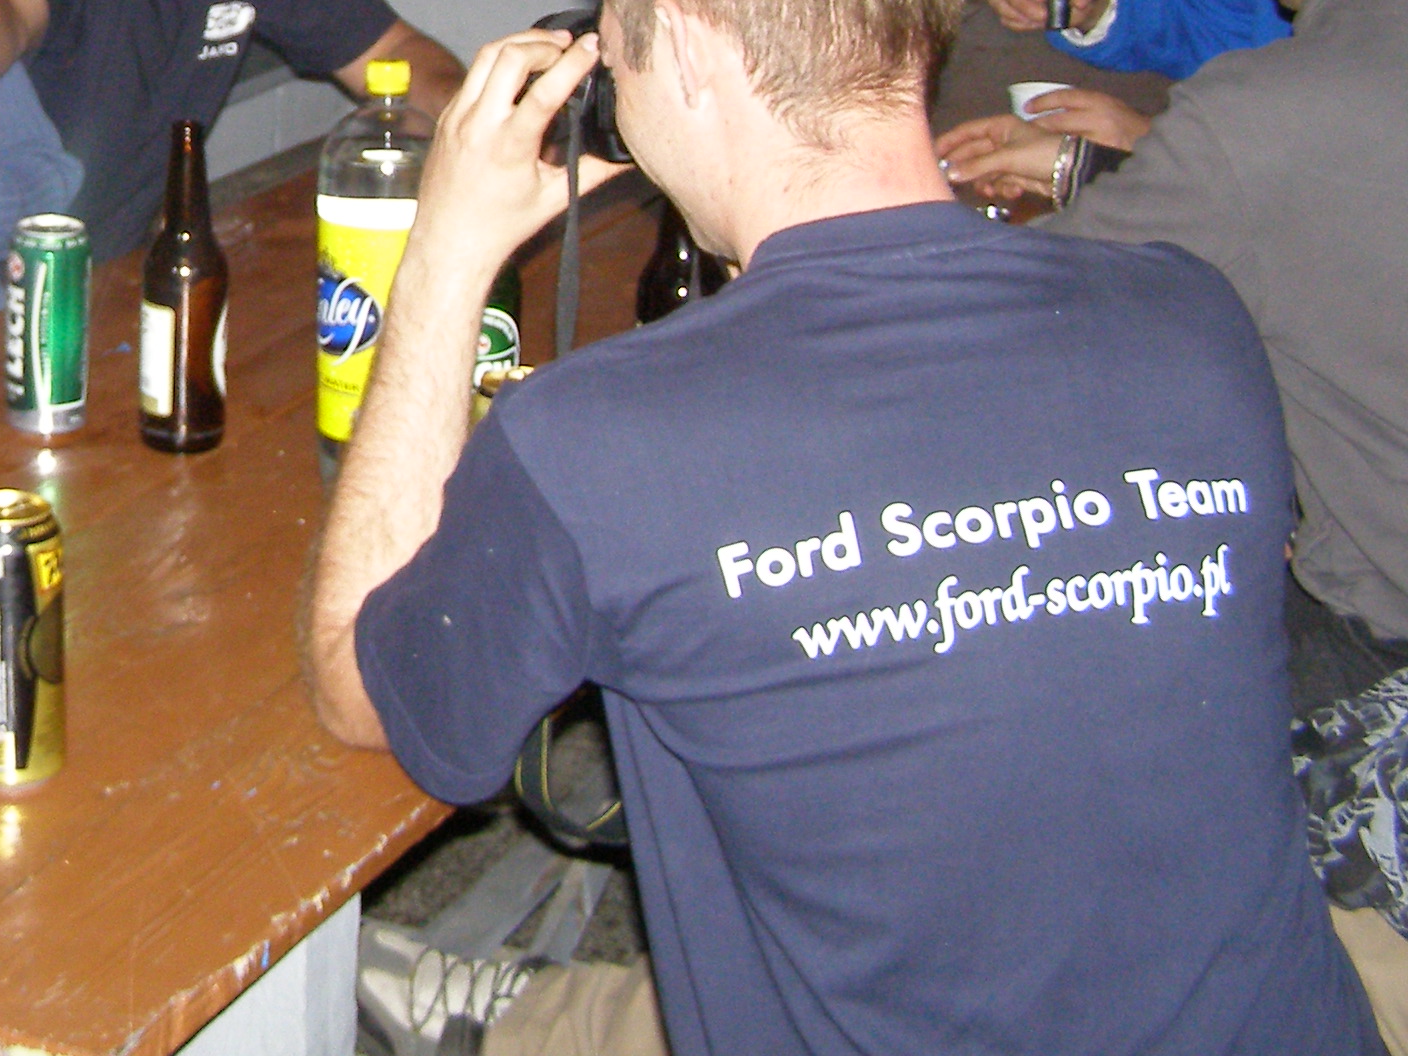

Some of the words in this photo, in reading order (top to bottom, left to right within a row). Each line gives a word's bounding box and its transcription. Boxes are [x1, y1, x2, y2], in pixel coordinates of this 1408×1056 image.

[317, 277, 375, 366] nley
[716, 510, 863, 600] Ford
[880, 479, 1113, 551] Scorpio
[1123, 467, 1249, 521] Team
[790, 543, 1233, 660] www.ford-scorpio.pl
